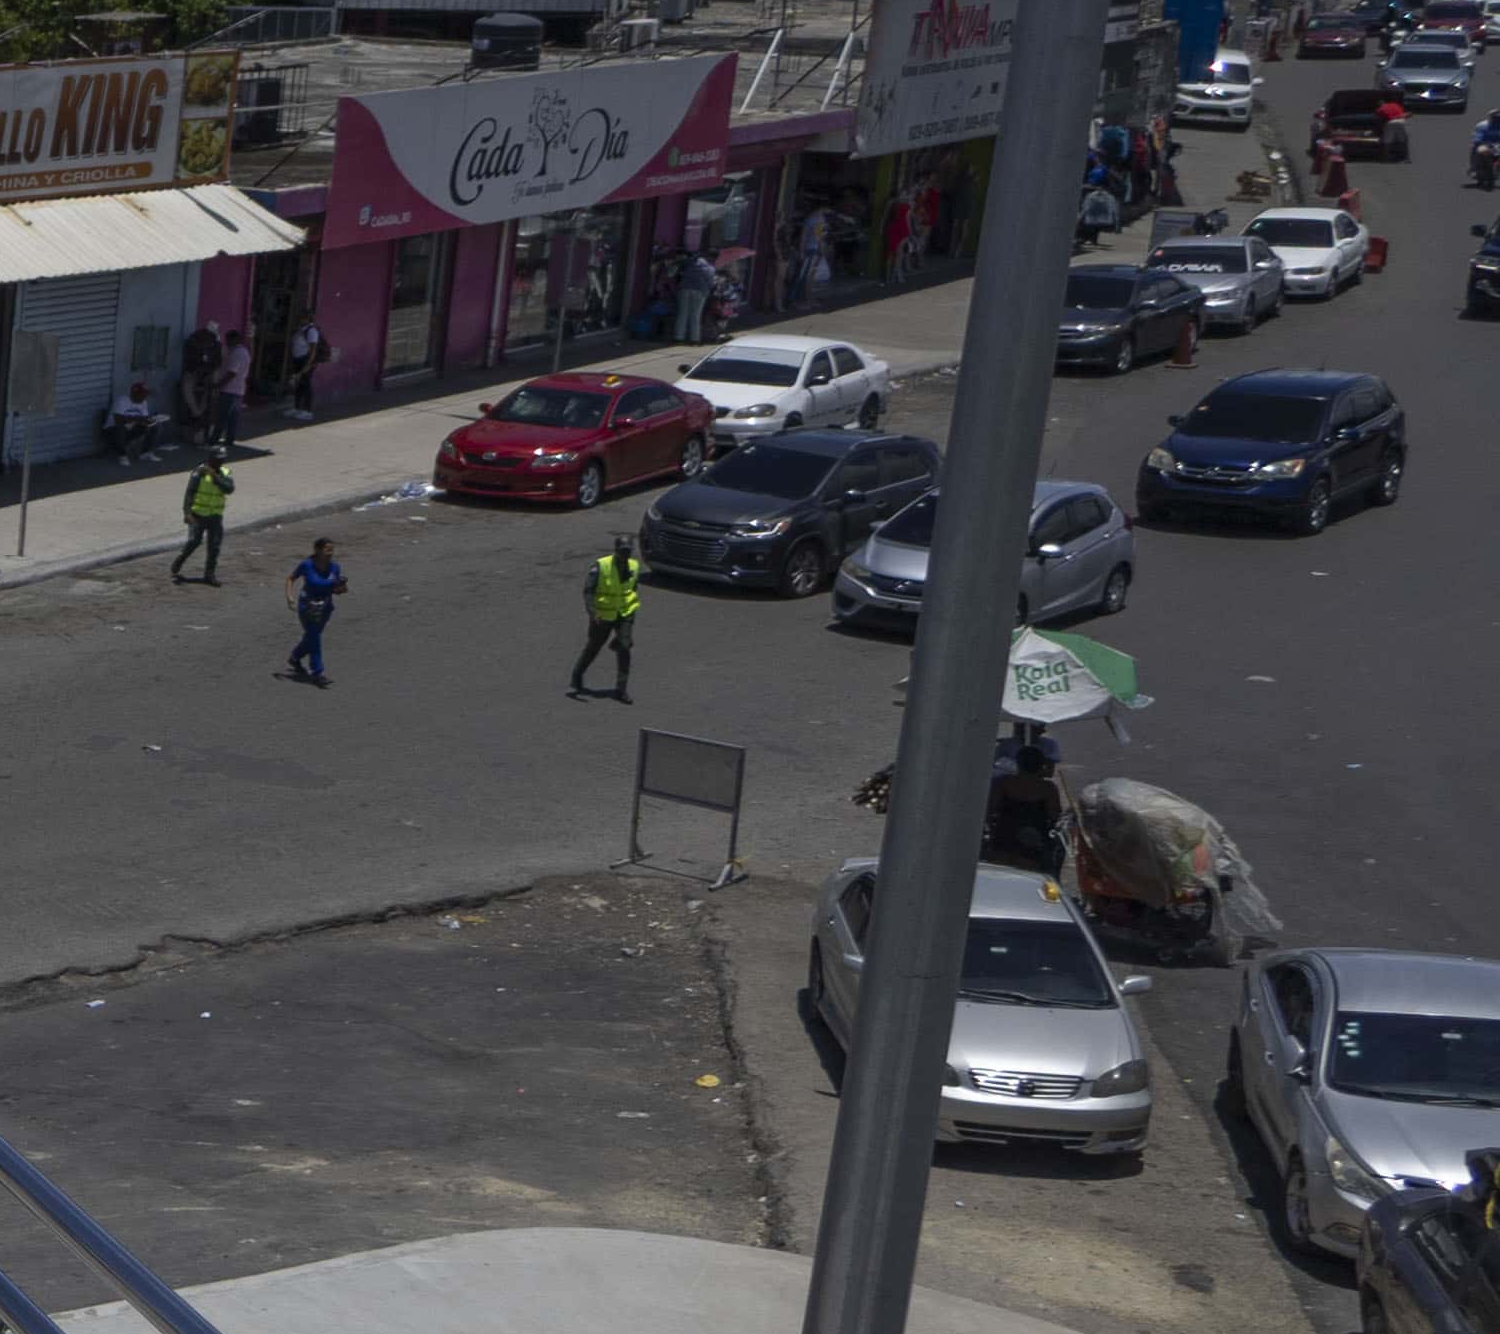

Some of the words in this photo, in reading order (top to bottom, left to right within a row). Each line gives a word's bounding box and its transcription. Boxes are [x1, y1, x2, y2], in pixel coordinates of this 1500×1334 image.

[50, 68, 168, 160] KING
[43, 174, 56, 185] Y
[60, 167, 138, 184] CRIOLLA
[450, 117, 525, 206] Cada
[1017, 675, 1071, 701] Real
